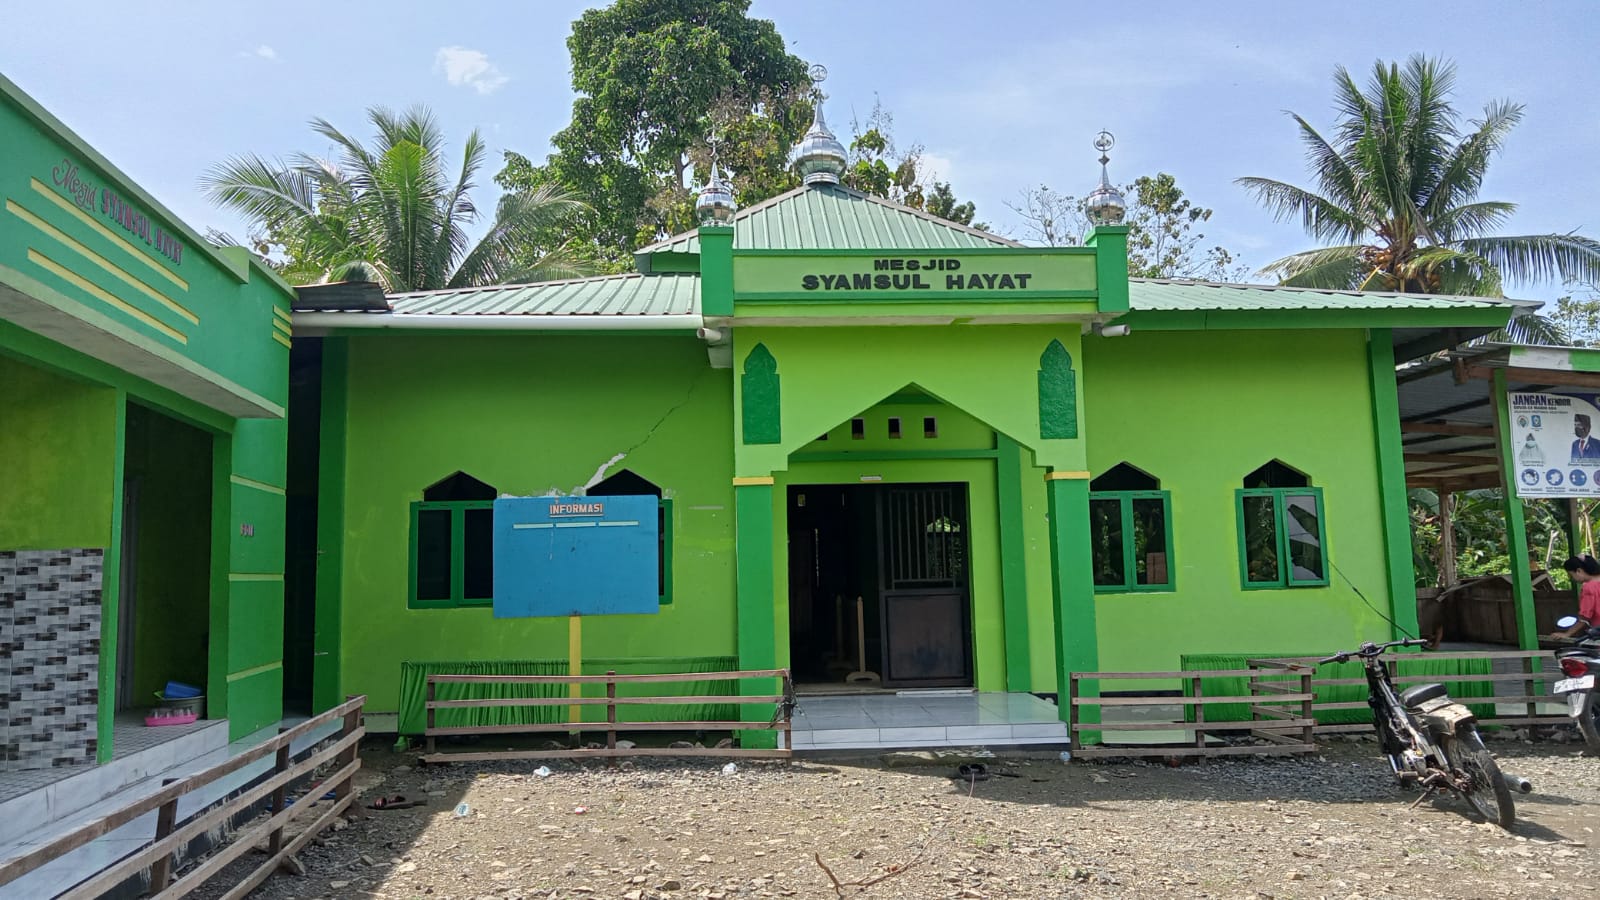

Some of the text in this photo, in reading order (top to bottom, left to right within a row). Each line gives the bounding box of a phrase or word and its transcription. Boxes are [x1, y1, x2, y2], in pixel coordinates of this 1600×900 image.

[874, 258, 961, 271] MESJID
[801, 273, 1032, 290] SYAMSUL HAYAT
[1513, 395, 1546, 405] JANGAN
[549, 503, 603, 514] INFORMASI
